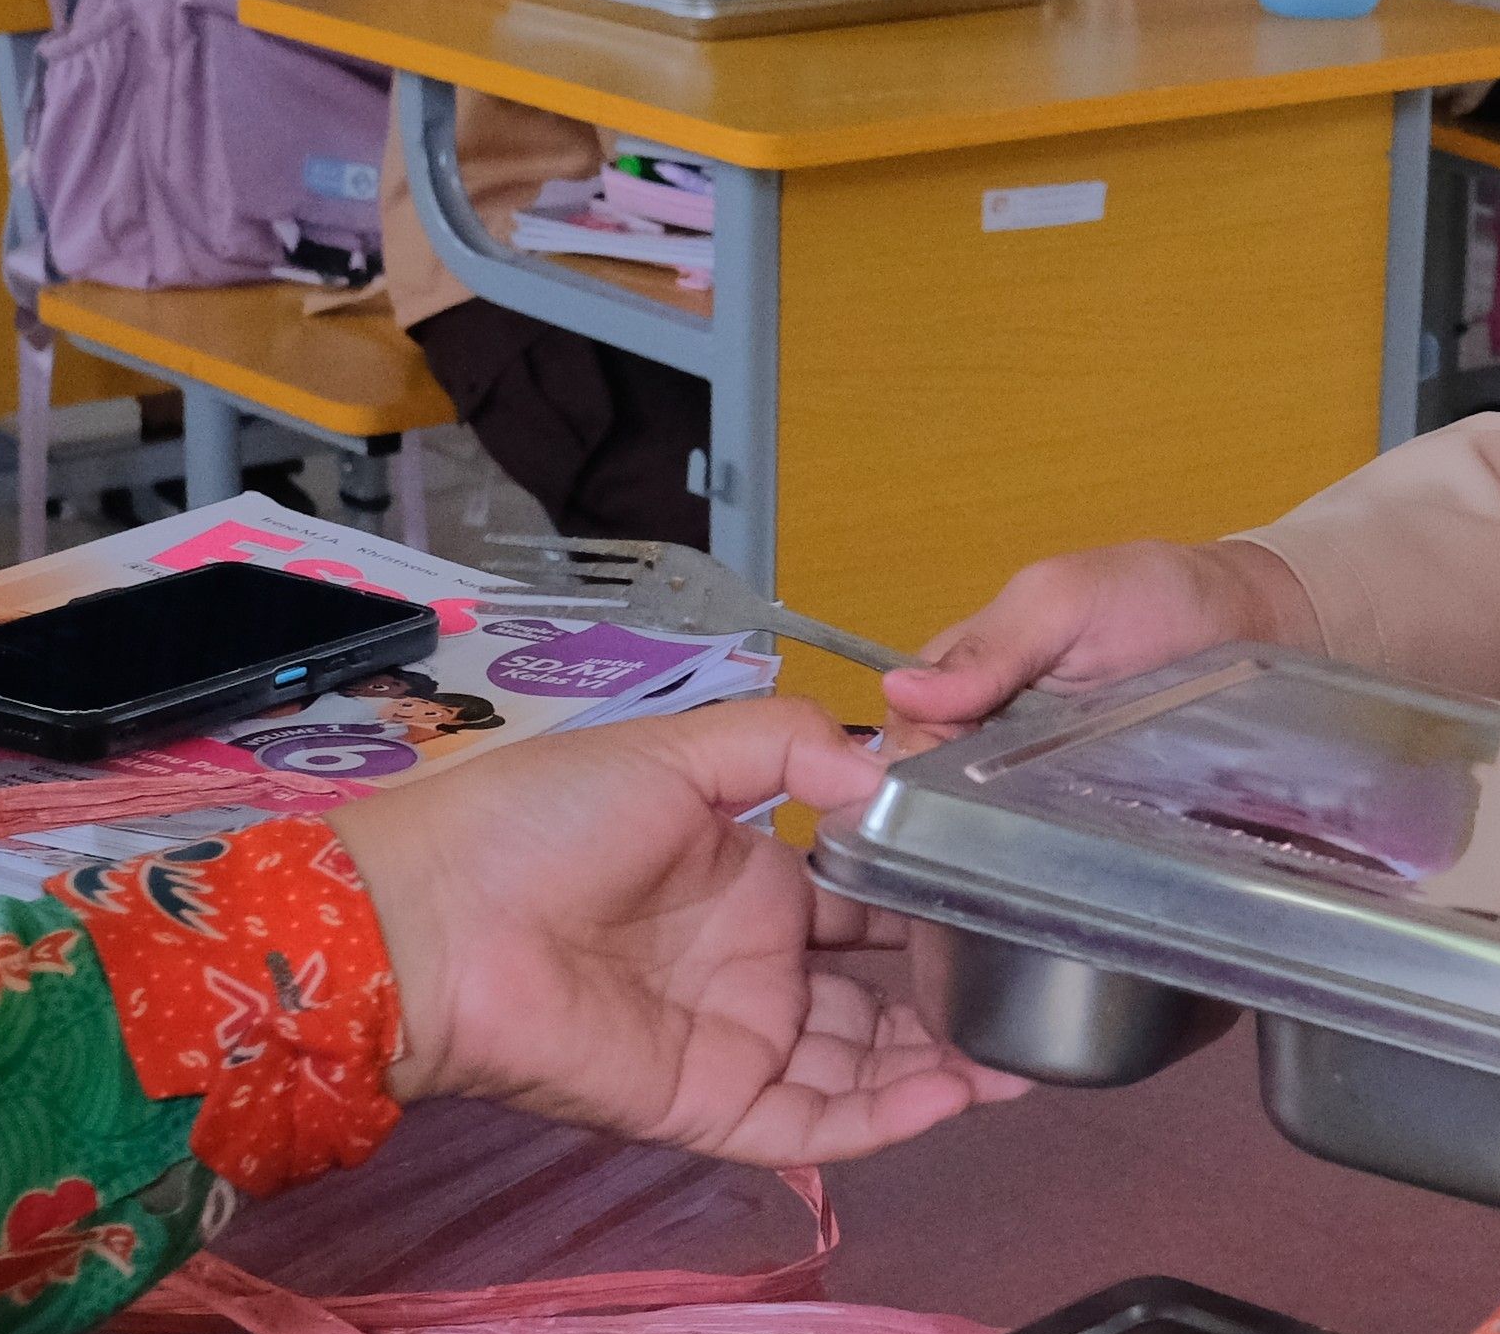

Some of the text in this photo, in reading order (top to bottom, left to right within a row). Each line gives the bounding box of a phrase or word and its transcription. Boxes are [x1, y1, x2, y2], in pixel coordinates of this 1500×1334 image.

[261, 516, 299, 533] Irene
[499, 654, 636, 681] SD/MI
[584, 657, 647, 669] untuk
[500, 668, 611, 690] Kelas VI
[242, 724, 345, 747] VOLUME 1
[284, 744, 396, 771] 6
